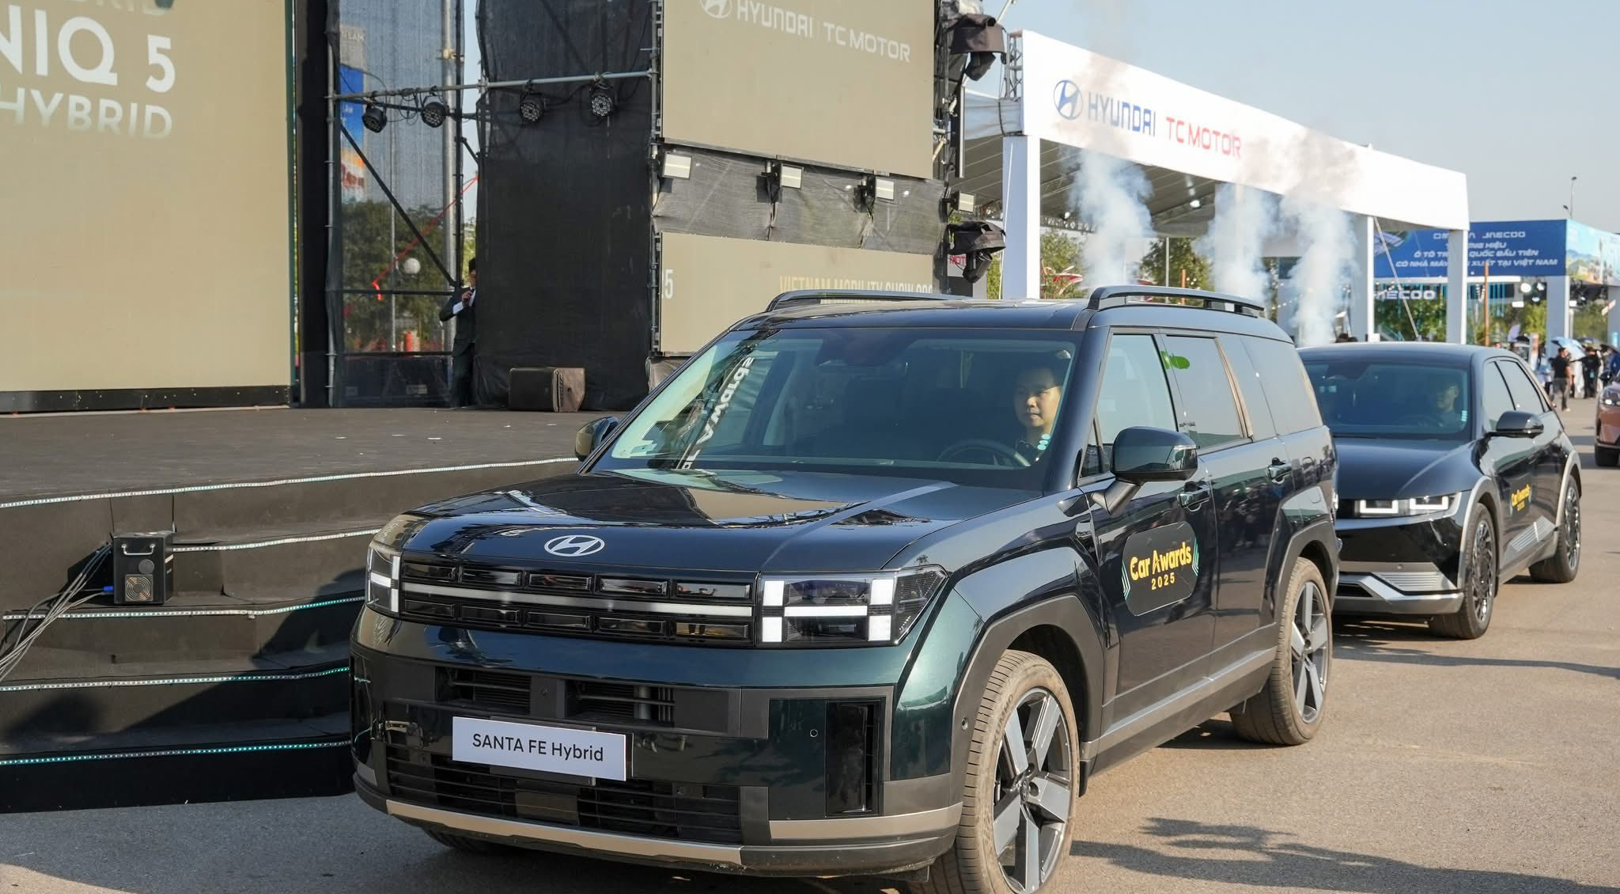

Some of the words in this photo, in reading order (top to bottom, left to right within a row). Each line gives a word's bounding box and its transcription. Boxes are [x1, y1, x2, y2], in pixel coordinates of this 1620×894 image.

[736, 0, 813, 39] HYUNDAI
[145, 34, 176, 93] 5
[0, 84, 173, 139] HYBRID
[1087, 91, 1156, 137] HYUNDAI
[1130, 556, 1150, 580] Car
[1152, 541, 1192, 575] Awards
[1151, 572, 1175, 590] 2025
[472, 733, 524, 752] SANTA
[528, 739, 547, 755] FE
[551, 742, 604, 762] Hybrid
